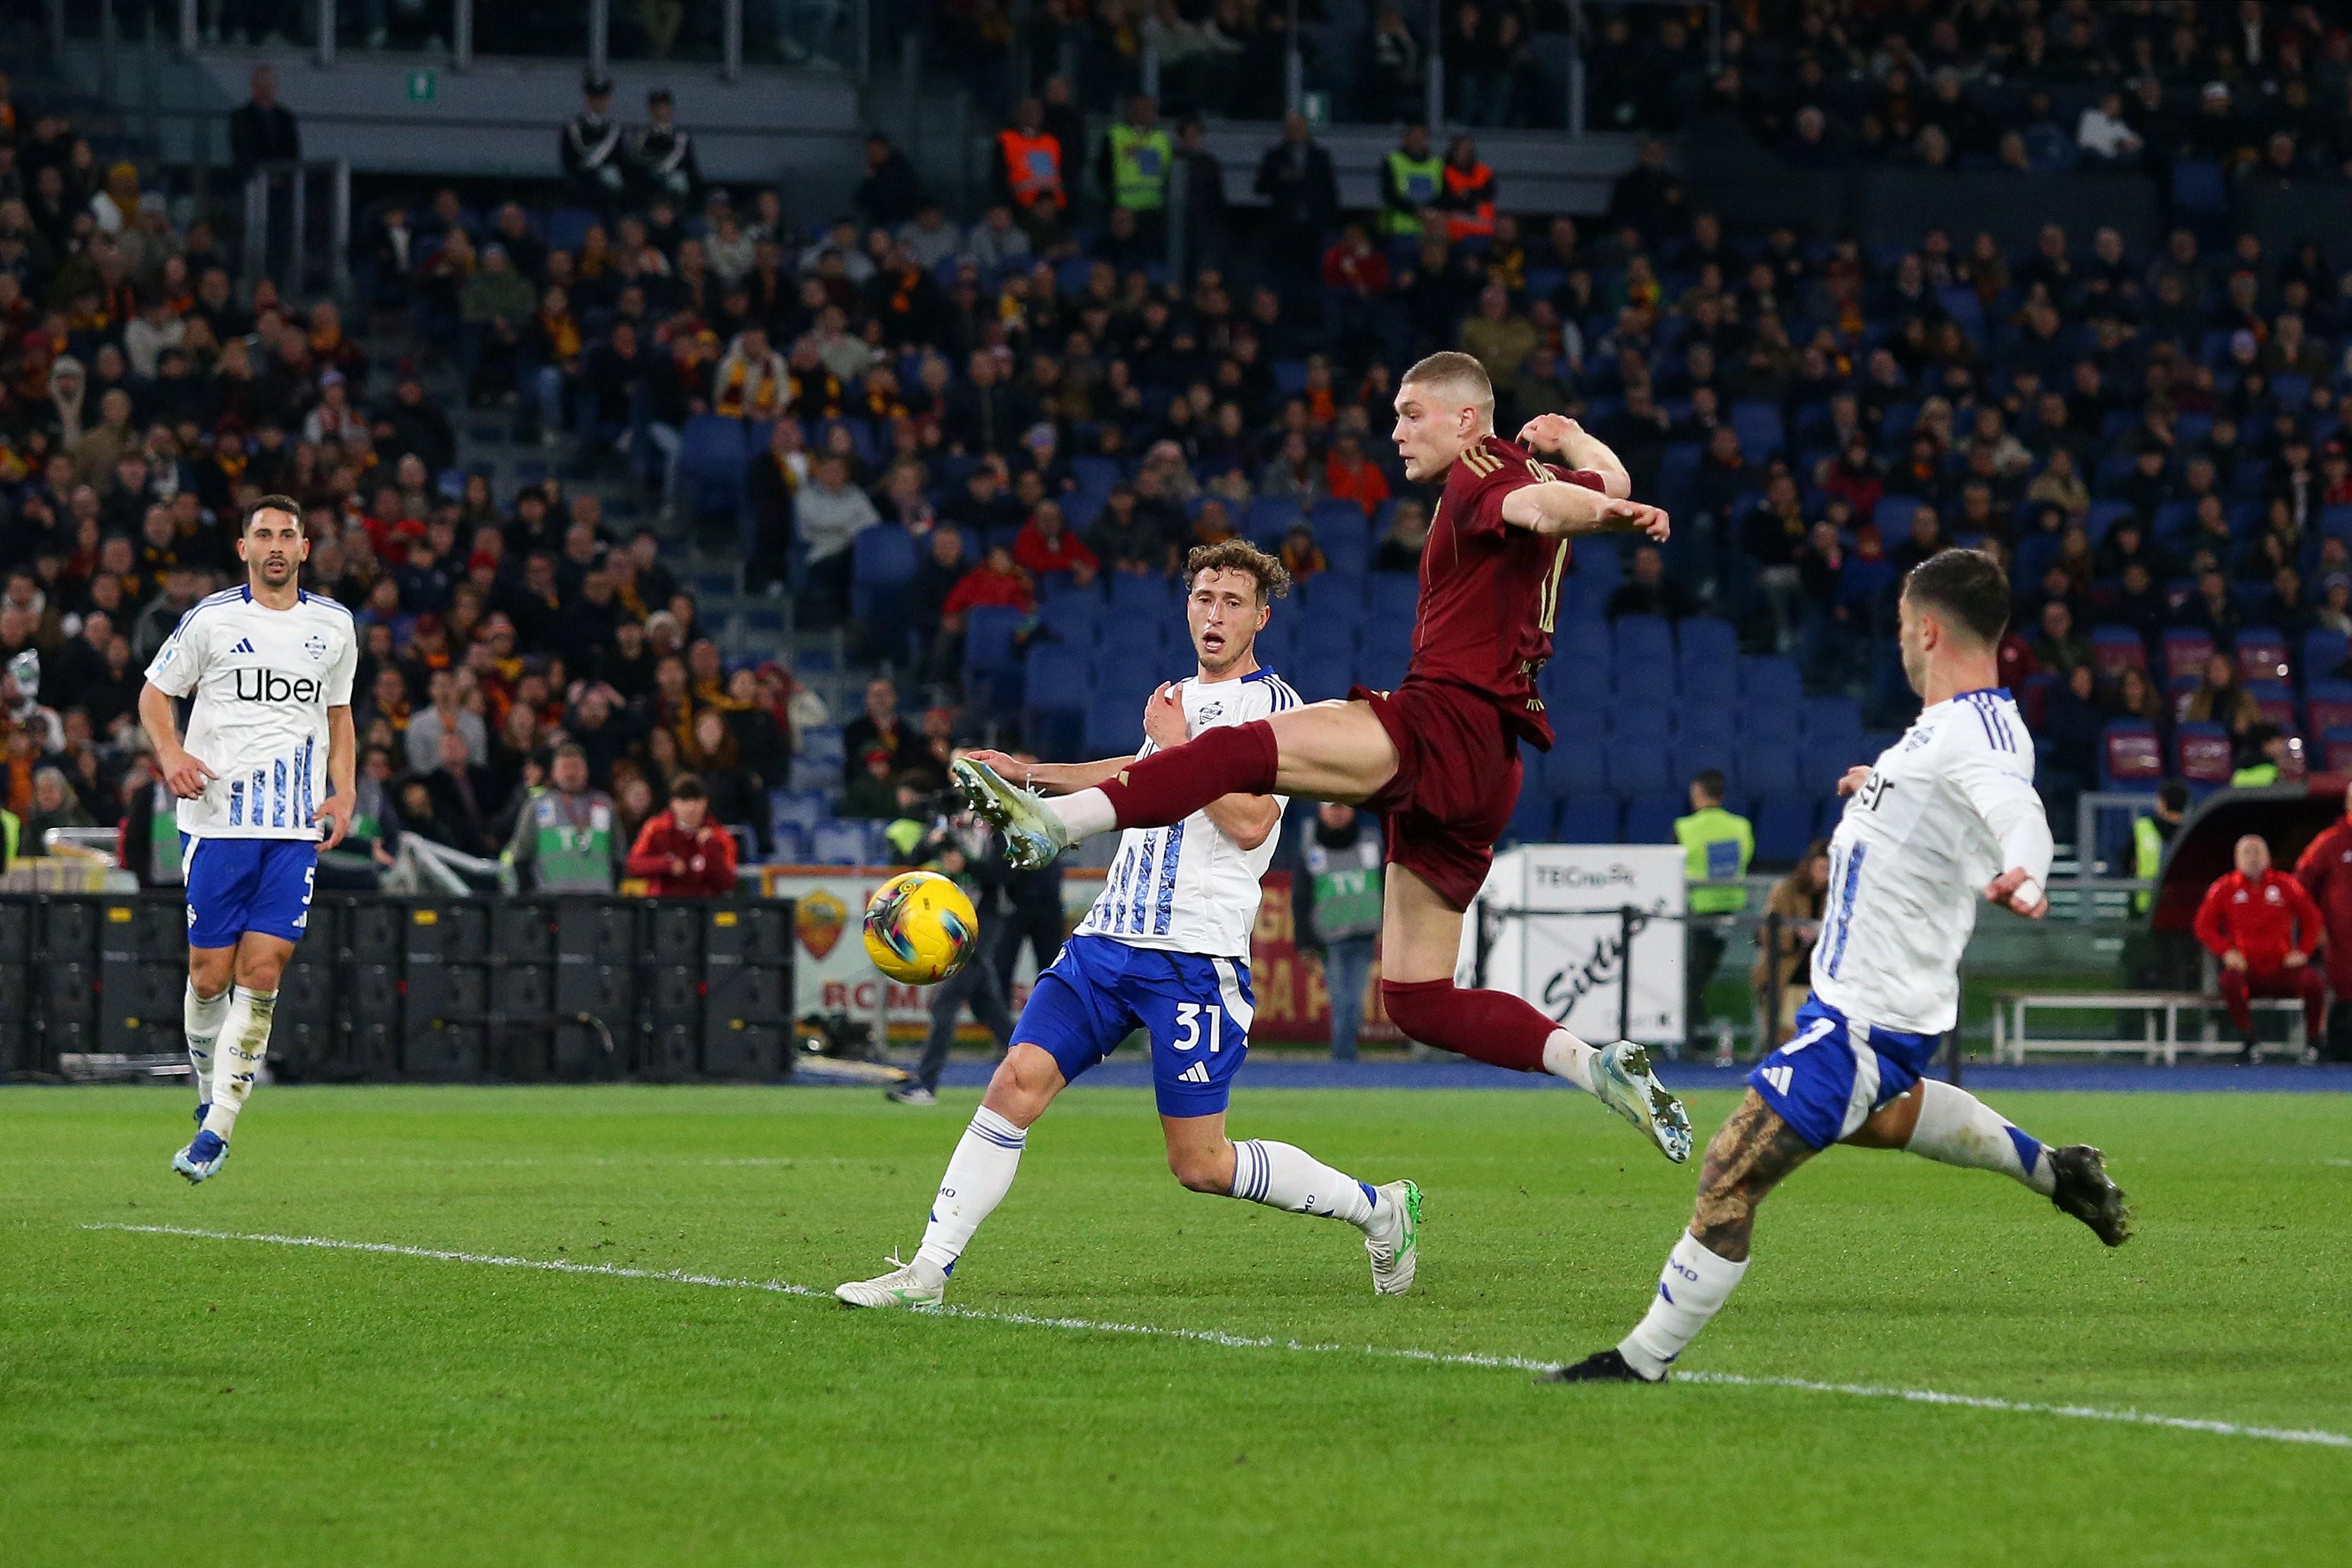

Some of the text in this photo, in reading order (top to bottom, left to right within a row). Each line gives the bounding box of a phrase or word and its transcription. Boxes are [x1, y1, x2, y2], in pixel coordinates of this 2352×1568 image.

[235, 668, 322, 703] Uber
[301, 867, 316, 906] 5
[1333, 873, 1366, 895] TV
[1173, 1002, 1220, 1052] 31
[1781, 1016, 1836, 1056] 7
